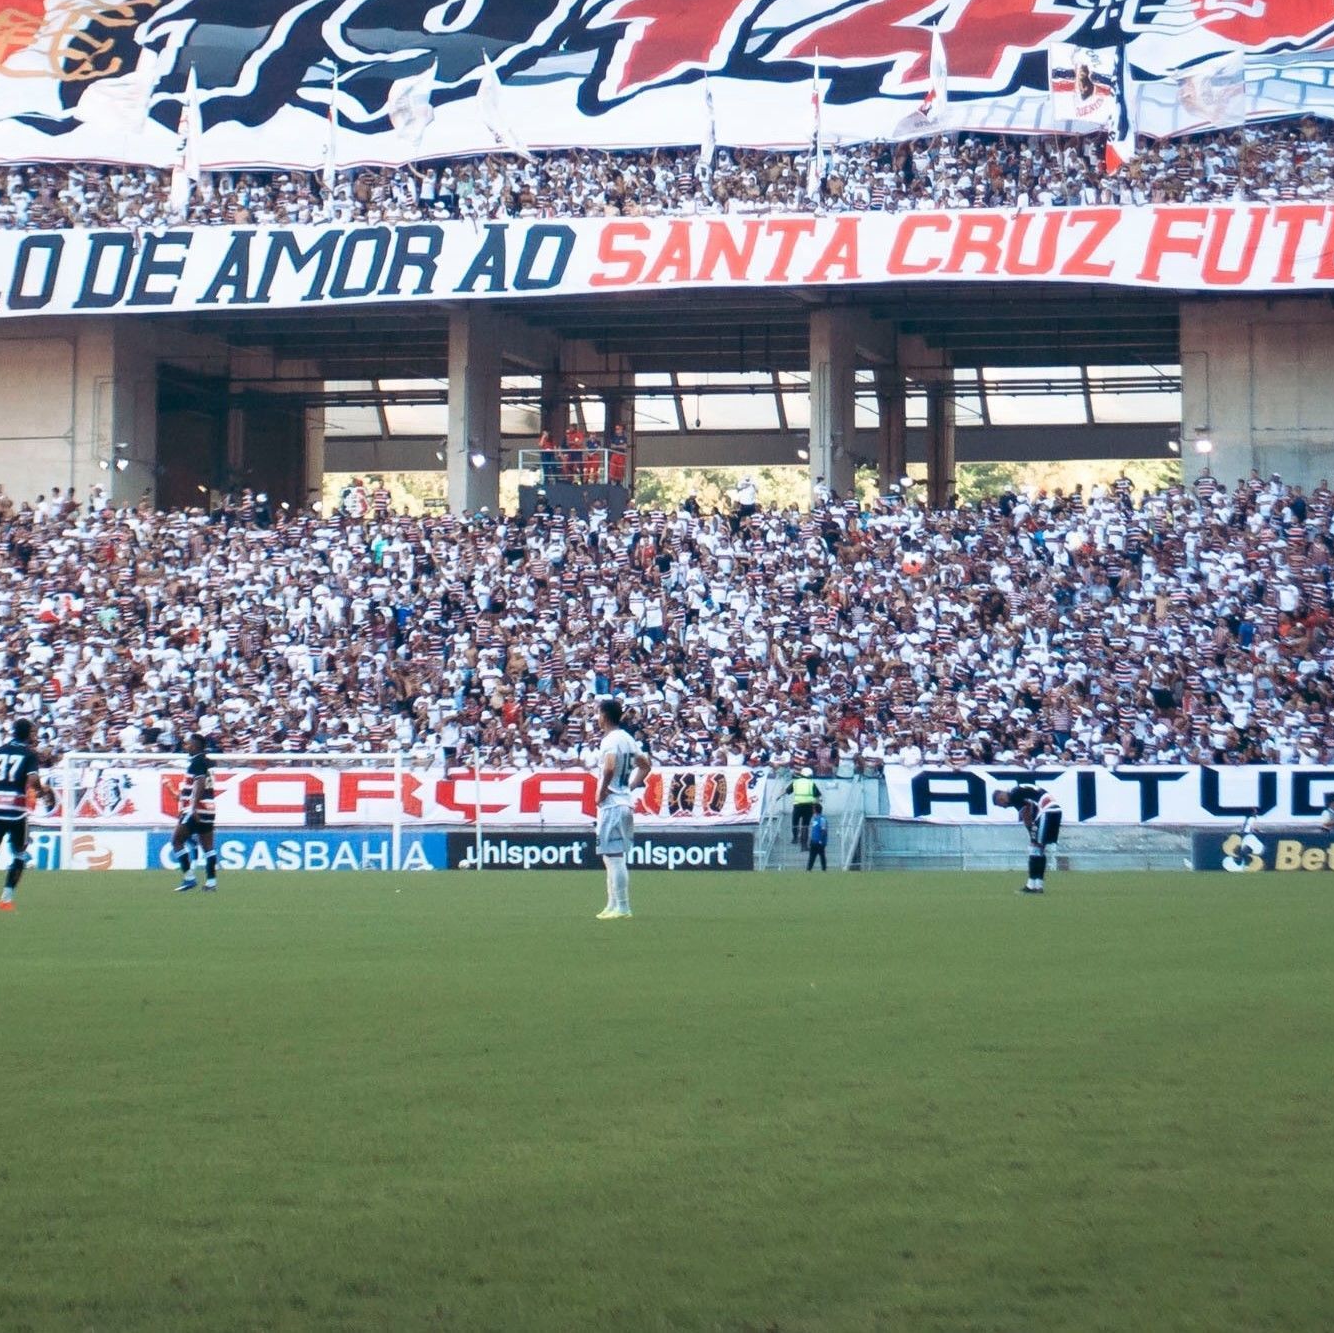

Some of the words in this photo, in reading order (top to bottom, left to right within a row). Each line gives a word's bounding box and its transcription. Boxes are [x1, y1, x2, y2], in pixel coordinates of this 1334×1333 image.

[73, 230, 193, 309] DE
[197, 223, 445, 304] AMOR
[453, 222, 576, 293] AO
[589, 216, 862, 287] SANTA
[887, 208, 1121, 277] CRUZ
